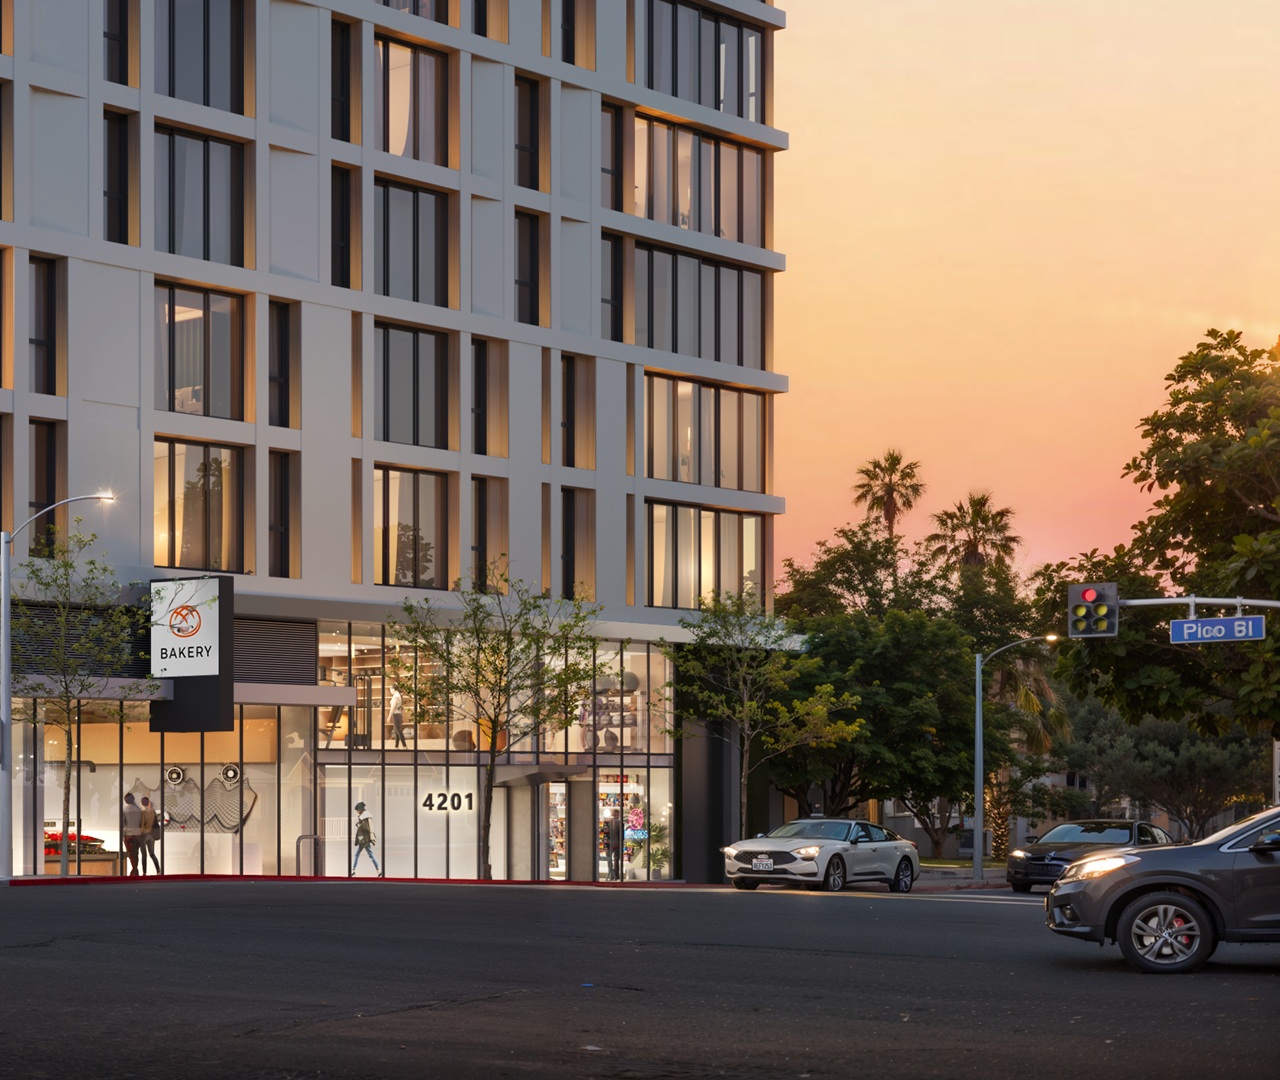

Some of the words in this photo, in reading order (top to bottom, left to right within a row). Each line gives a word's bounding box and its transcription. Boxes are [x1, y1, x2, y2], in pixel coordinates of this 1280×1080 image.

[1183, 623, 1225, 639] Pico
[1234, 621, 1253, 637] Bl
[160, 645, 212, 659] BAKERY
[422, 792, 473, 811] 4201
